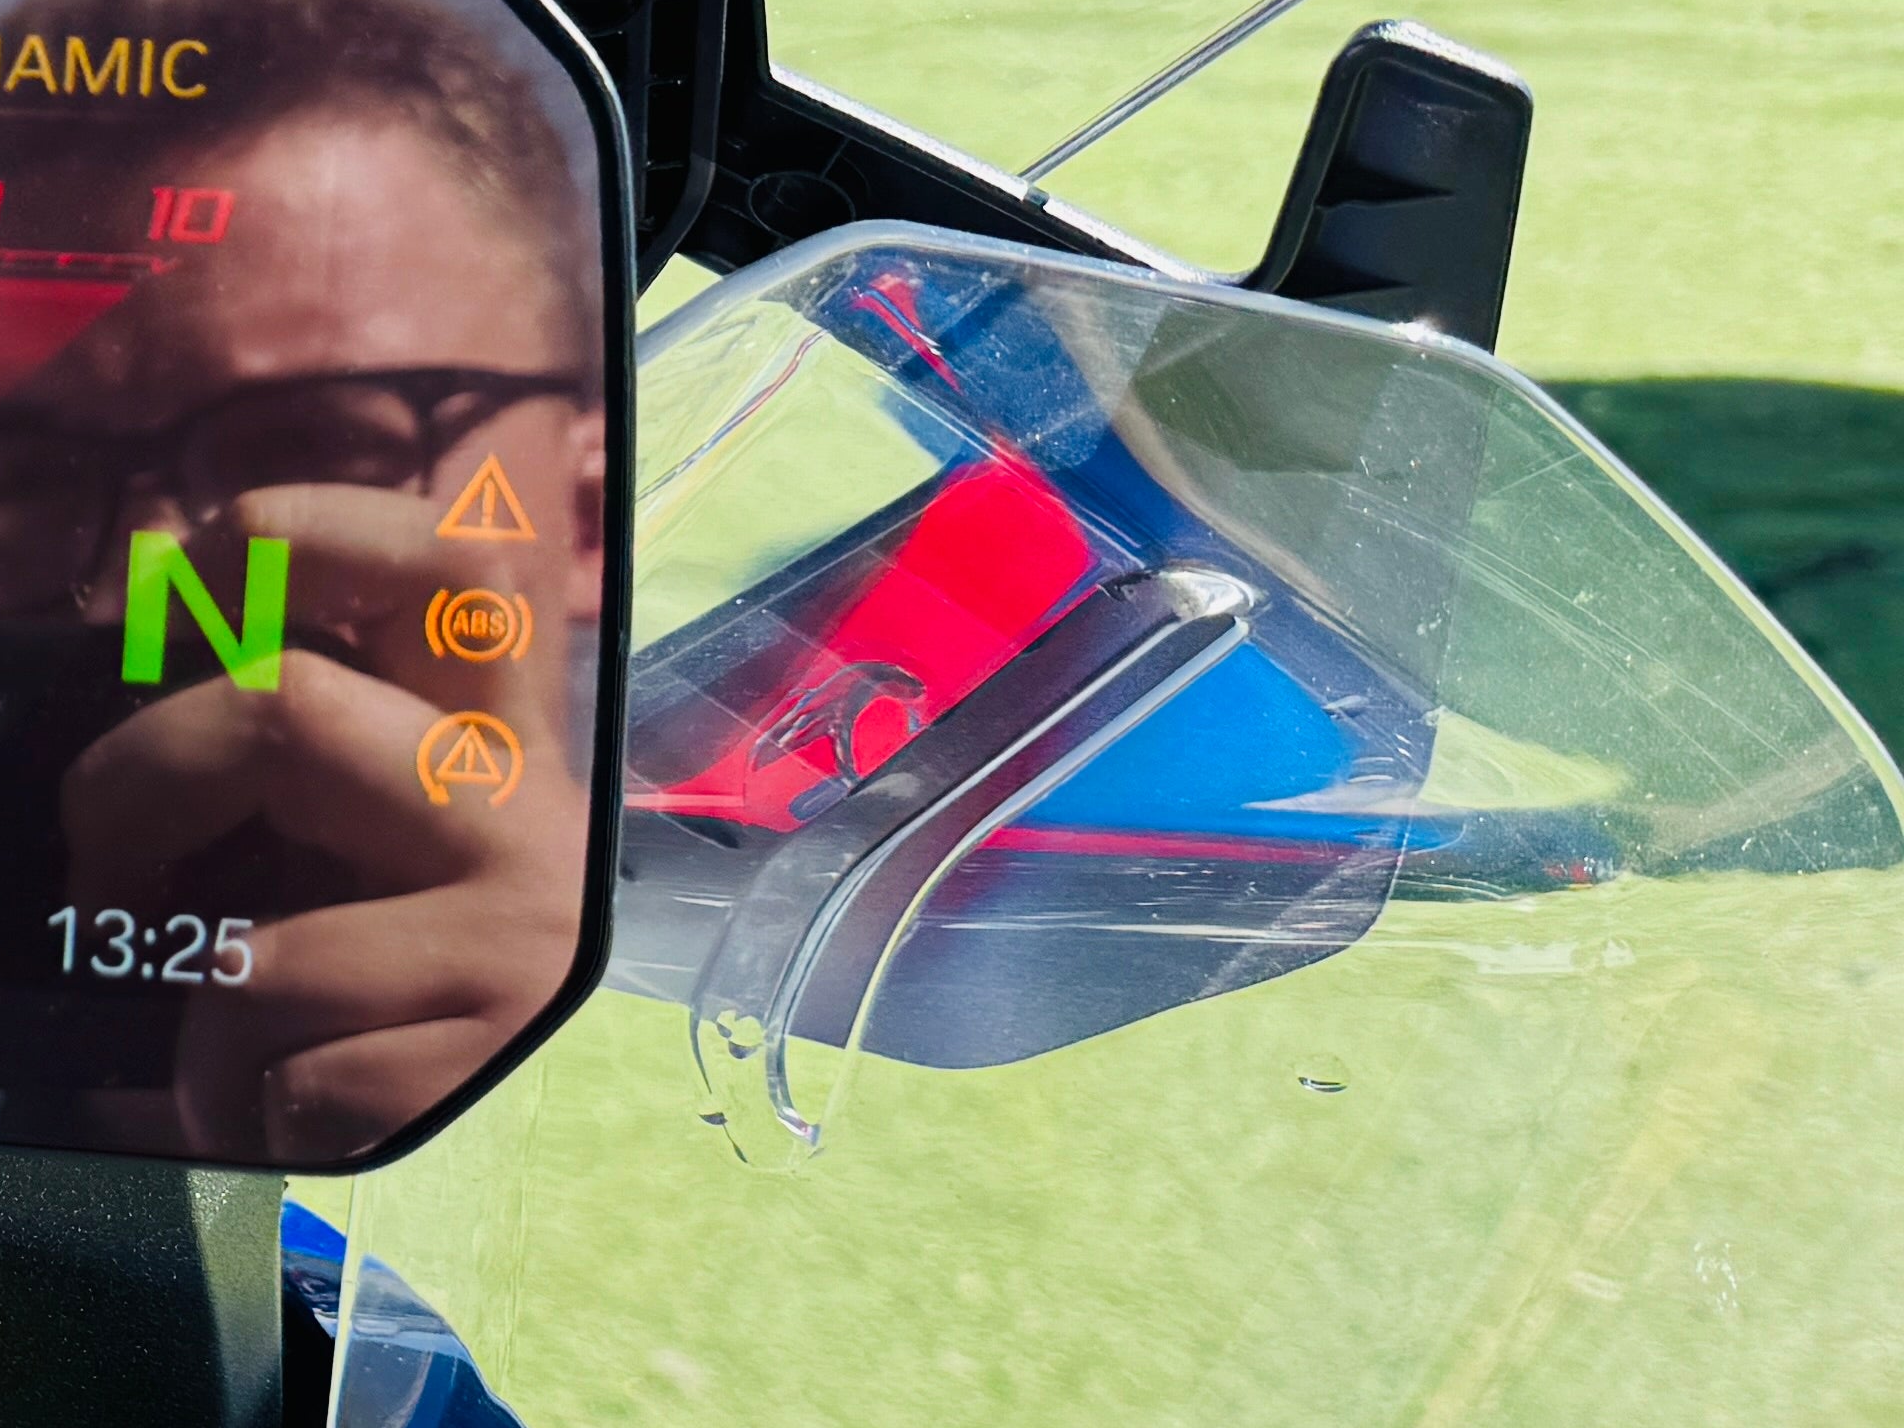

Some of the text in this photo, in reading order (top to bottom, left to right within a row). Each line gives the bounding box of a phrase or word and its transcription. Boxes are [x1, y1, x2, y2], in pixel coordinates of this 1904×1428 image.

[148, 185, 235, 244] 10
[121, 530, 292, 692] N
[453, 608, 506, 639] ABS
[47, 905, 256, 986] 13:25
